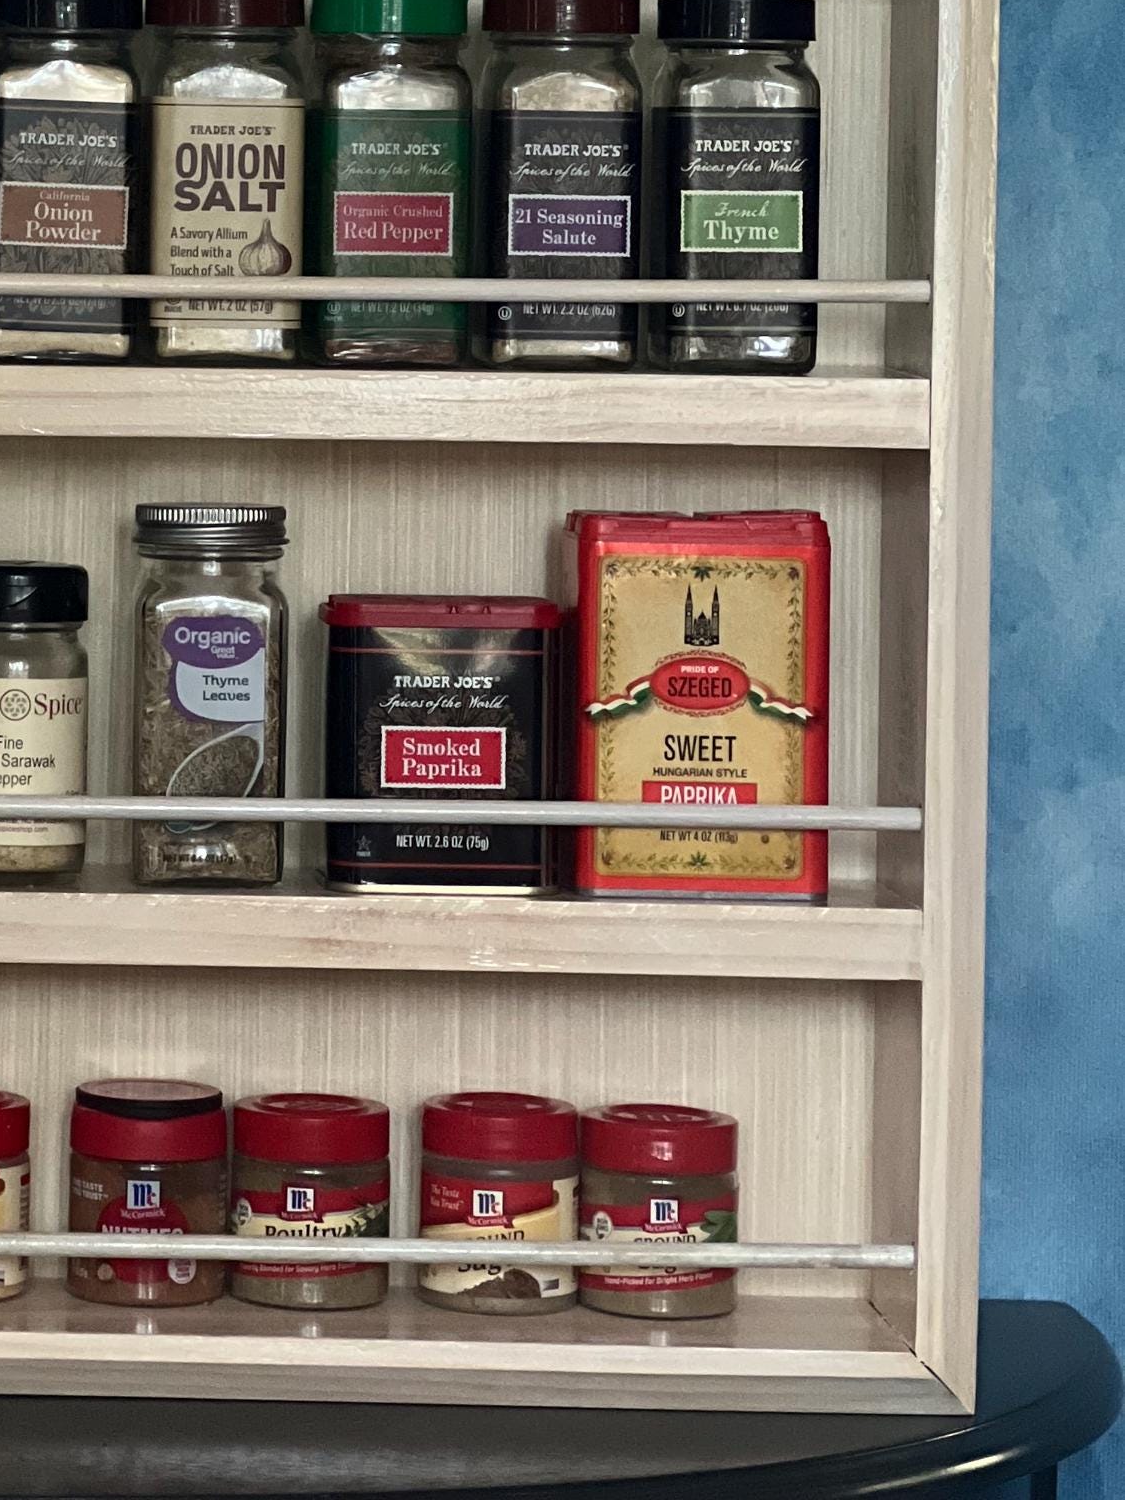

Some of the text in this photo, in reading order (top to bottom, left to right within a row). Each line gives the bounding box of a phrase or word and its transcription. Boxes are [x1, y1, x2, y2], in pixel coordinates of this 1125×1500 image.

[524, 143, 623, 157] TRADER JOE'S
[694, 139, 793, 153] TRADER JOE'S
[175, 142, 285, 182] ONION
[680, 157, 808, 178] Spices of the World
[173, 180, 286, 213] SALT
[34, 201, 94, 222] Onion
[343, 205, 443, 219] Organic Crushed
[714, 200, 770, 218] French
[515, 208, 624, 229] 21 Seasoning
[26, 220, 101, 242] Powder
[170, 227, 248, 243] A Savory Allium
[344, 221, 443, 243] Red Pepper
[542, 229, 597, 246] Salute
[703, 219, 779, 244] Thyme
[170, 246, 232, 258] Blend with a
[170, 264, 235, 277] Touch of Salt
[174, 627, 251, 649] Organic
[681, 665, 719, 674] PRIDE OF
[203, 675, 249, 690] Thyme
[394, 675, 494, 689] TRADER JOE'S
[667, 676, 732, 698] SZEGED
[203, 690, 251, 703] Leaves
[33, 693, 82, 720] Spice
[402, 737, 480, 757] Smoked
[663, 734, 737, 763] SWEET
[1, 753, 56, 769] Sarawak
[402, 758, 483, 779] Paprika
[653, 767, 748, 779] HUNGARIAN STYLE
[661, 785, 738, 804] PAPRIKA
[396, 835, 490, 852] NET WT. 2.6 OZ (75g)
